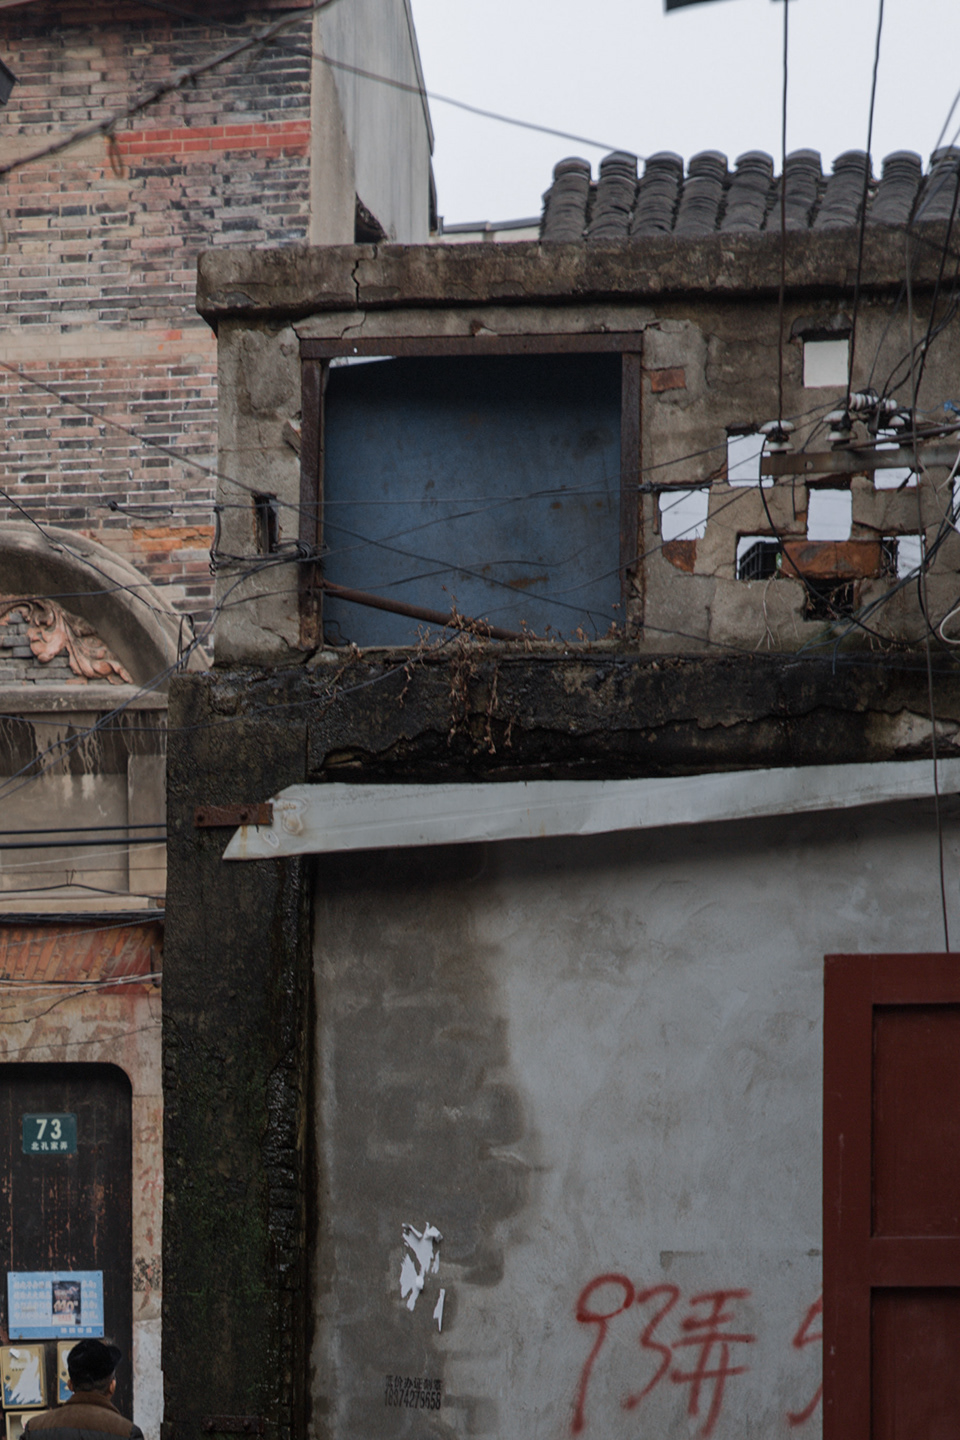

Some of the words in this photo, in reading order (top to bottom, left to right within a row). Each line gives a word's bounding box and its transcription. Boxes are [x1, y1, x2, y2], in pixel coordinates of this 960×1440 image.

[36, 1118, 62, 1140] 73
[31, 1141, 68, 1151] 北孔家弄
